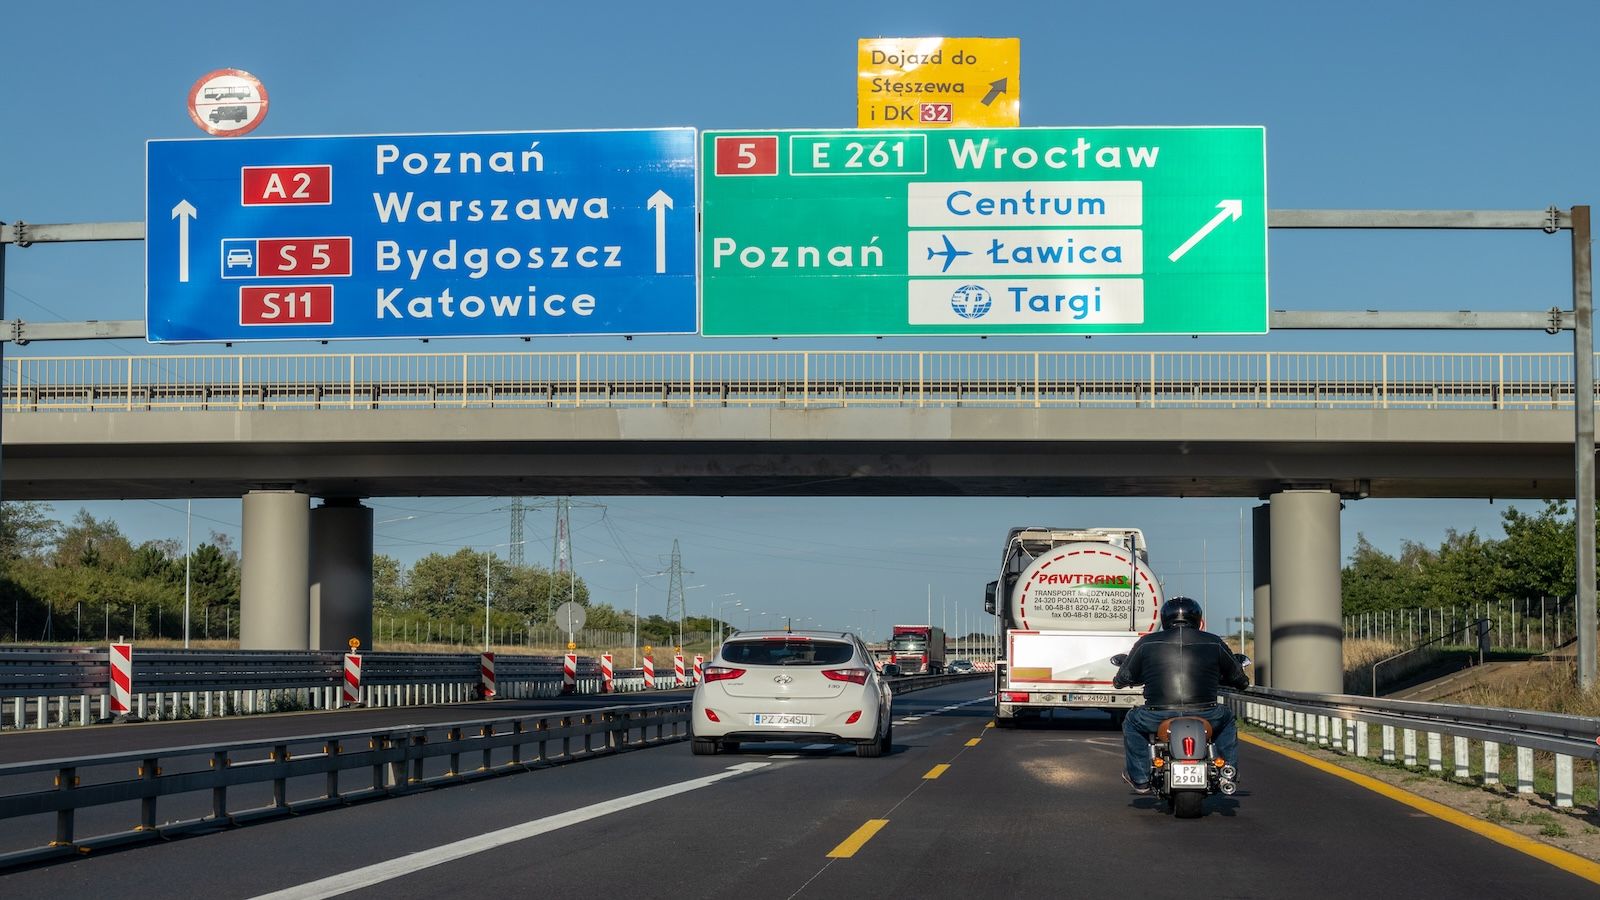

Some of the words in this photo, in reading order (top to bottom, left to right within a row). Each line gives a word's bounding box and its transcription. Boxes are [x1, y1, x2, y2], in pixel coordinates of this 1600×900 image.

[872, 50, 942, 68] Dojazd
[951, 50, 977, 65] do
[871, 77, 965, 97] Stęszewa
[871, 105, 876, 121] i
[884, 105, 915, 121] DK
[923, 104, 949, 121] 32
[376, 141, 544, 175] Poznań
[737, 143, 757, 169] 5
[812, 142, 830, 168] E
[844, 140, 904, 168] 261
[948, 137, 1160, 169] Wrocław
[373, 191, 609, 223] Warszawa
[946, 188, 1106, 216] Centrum
[376, 239, 622, 280] Bydgoszcz
[713, 236, 884, 268] Poznań
[986, 238, 1123, 264] Ławica
[260, 292, 312, 319] S11
[376, 285, 596, 319] Katowice
[1007, 286, 1101, 320] Targi
[1038, 574, 1124, 585] PAWTRANS
[1078, 590, 1145, 598] MĘDZYNARODWY
[1094, 612, 1128, 620] 820-34-58
[761, 715, 774, 724] PZ
[777, 715, 808, 725] 754SU
[1183, 766, 1197, 774] PZ
